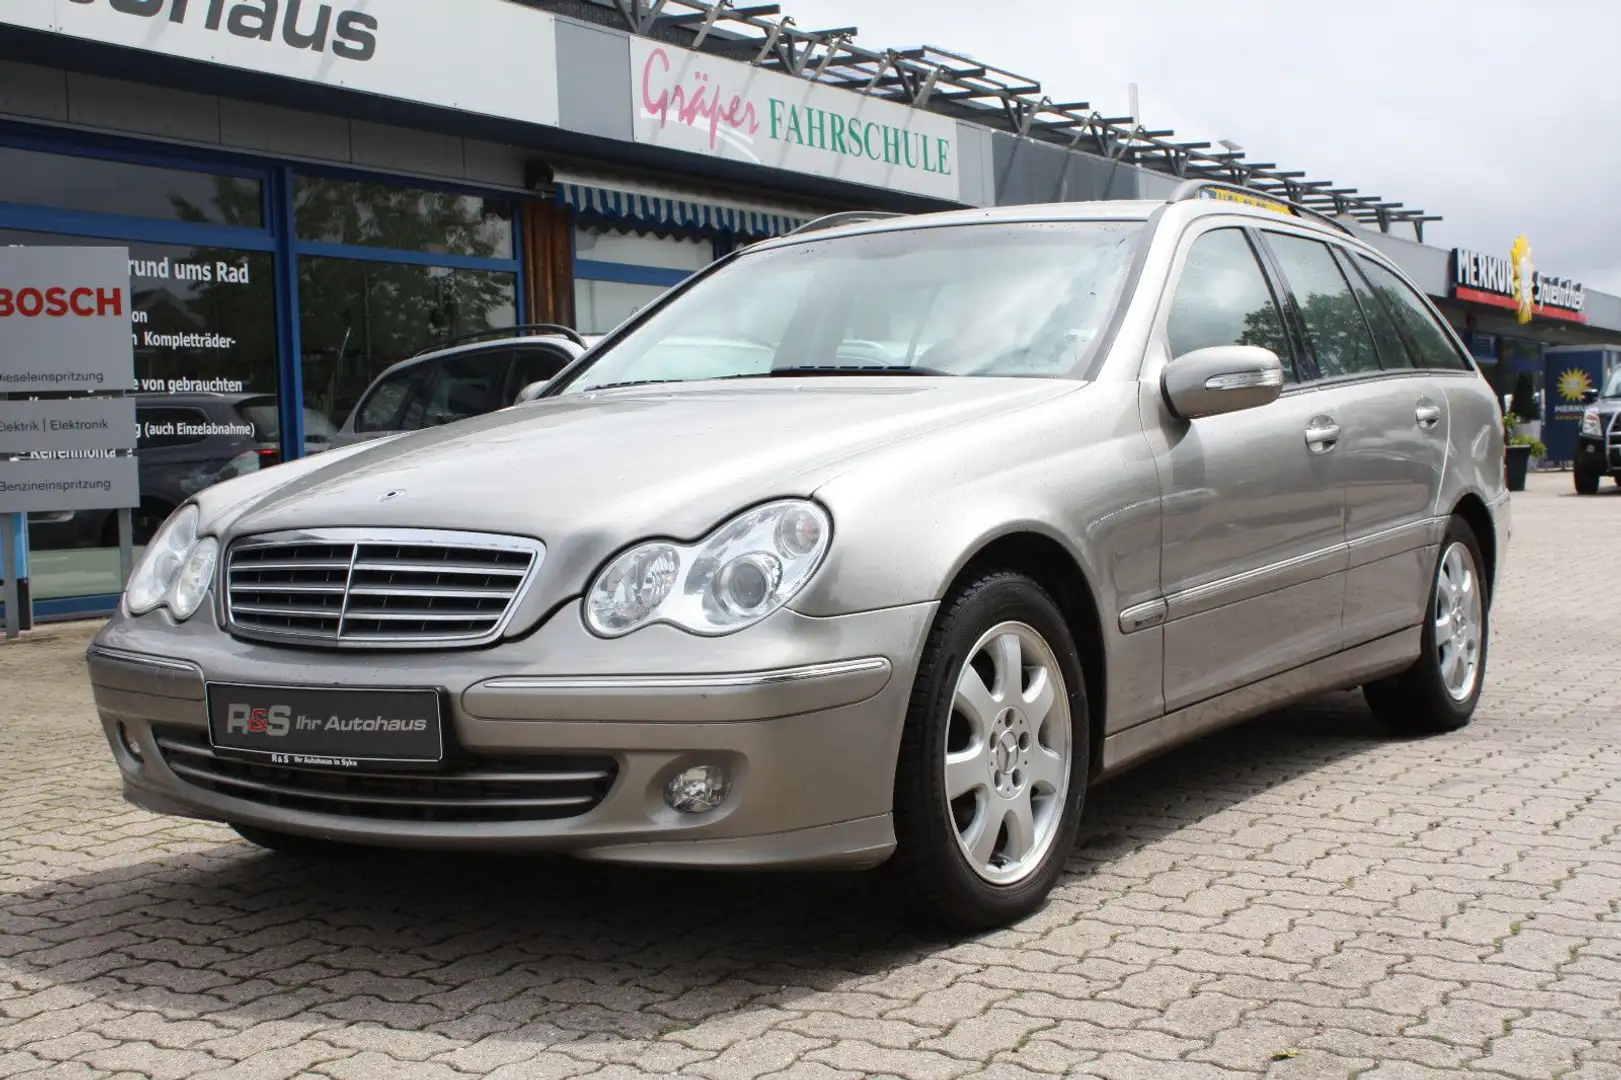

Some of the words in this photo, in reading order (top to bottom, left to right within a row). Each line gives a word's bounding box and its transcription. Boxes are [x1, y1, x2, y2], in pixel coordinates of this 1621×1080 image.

[642, 48, 759, 149] Gräper
[768, 98, 951, 175] FAHRSCHULE
[128, 257, 169, 278] rund
[174, 262, 212, 281] ums
[216, 261, 249, 283] Rad
[1457, 249, 1514, 296] MERKUR
[0, 287, 122, 317] BOSCH
[144, 331, 236, 350] Kompletträder-
[0, 371, 104, 383] ieseleinspritzung
[142, 379, 165, 391] von
[168, 376, 243, 394] gebrauchten
[50, 418, 109, 431] Elektronik
[145, 422, 174, 438] (auch
[177, 422, 255, 437] Einzelabnahme)
[0, 480, 111, 492] Benzineinspritzung
[227, 703, 292, 736] R&S
[296, 716, 322, 730] Ihr
[324, 715, 427, 731] Autohaus
